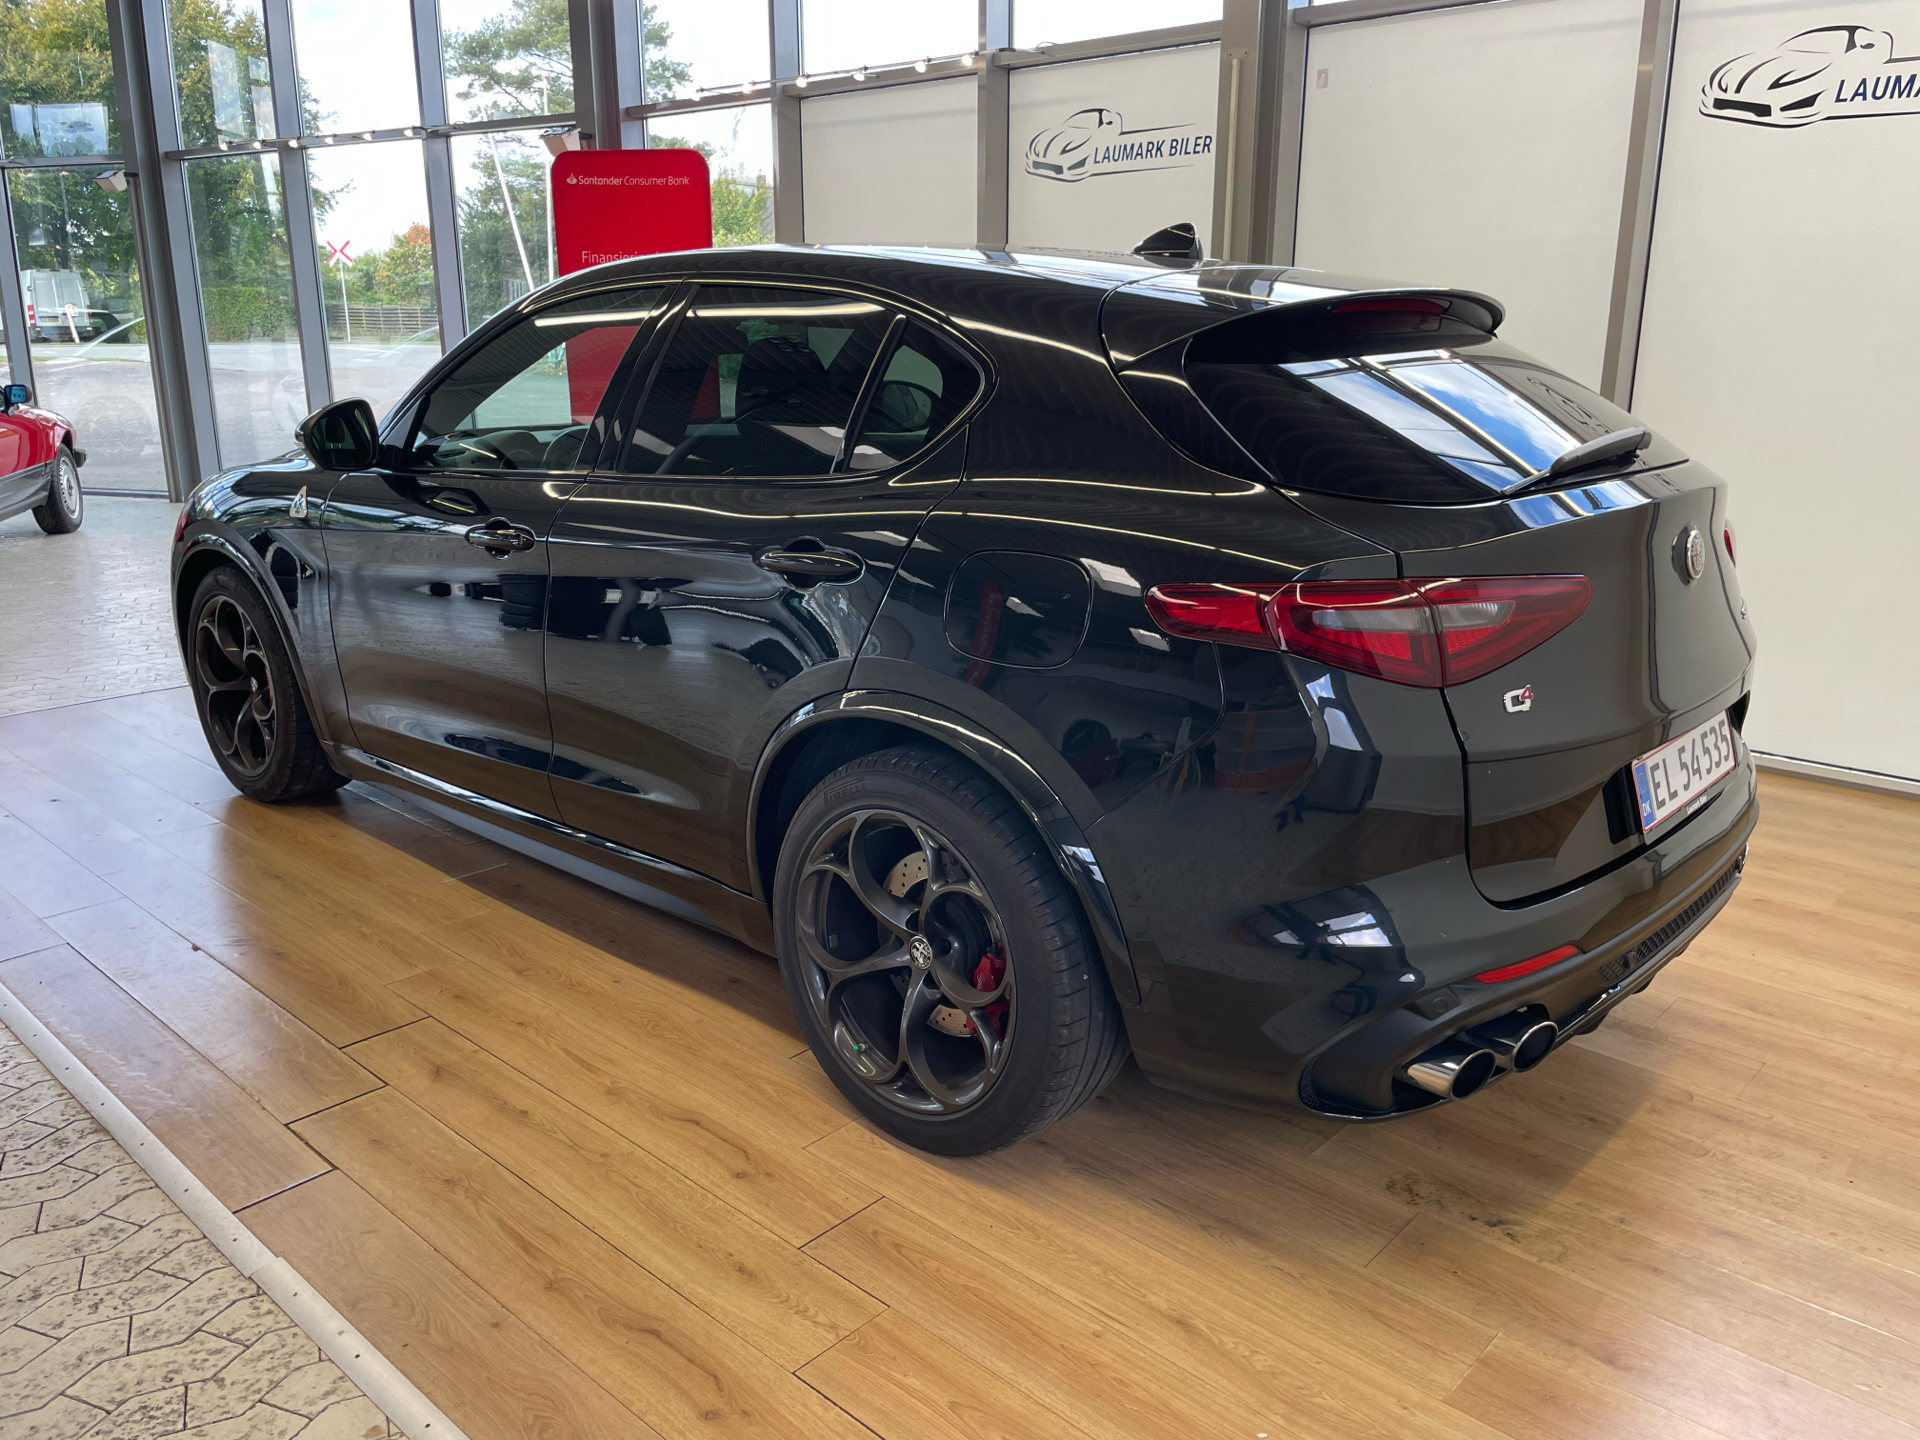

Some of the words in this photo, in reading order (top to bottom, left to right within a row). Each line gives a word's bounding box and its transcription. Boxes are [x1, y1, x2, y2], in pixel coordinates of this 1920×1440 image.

[1834, 73, 1920, 103] LAUM
[1093, 139, 1166, 164] LAUMARK
[1168, 135, 1213, 157] BILER
[578, 175, 622, 186] Santander
[623, 175, 666, 186] Consumer
[668, 176, 690, 186] Bank
[824, 776, 865, 806] PIRELLI
[1650, 758, 1678, 811] EL
[1642, 800, 1651, 816] DK
